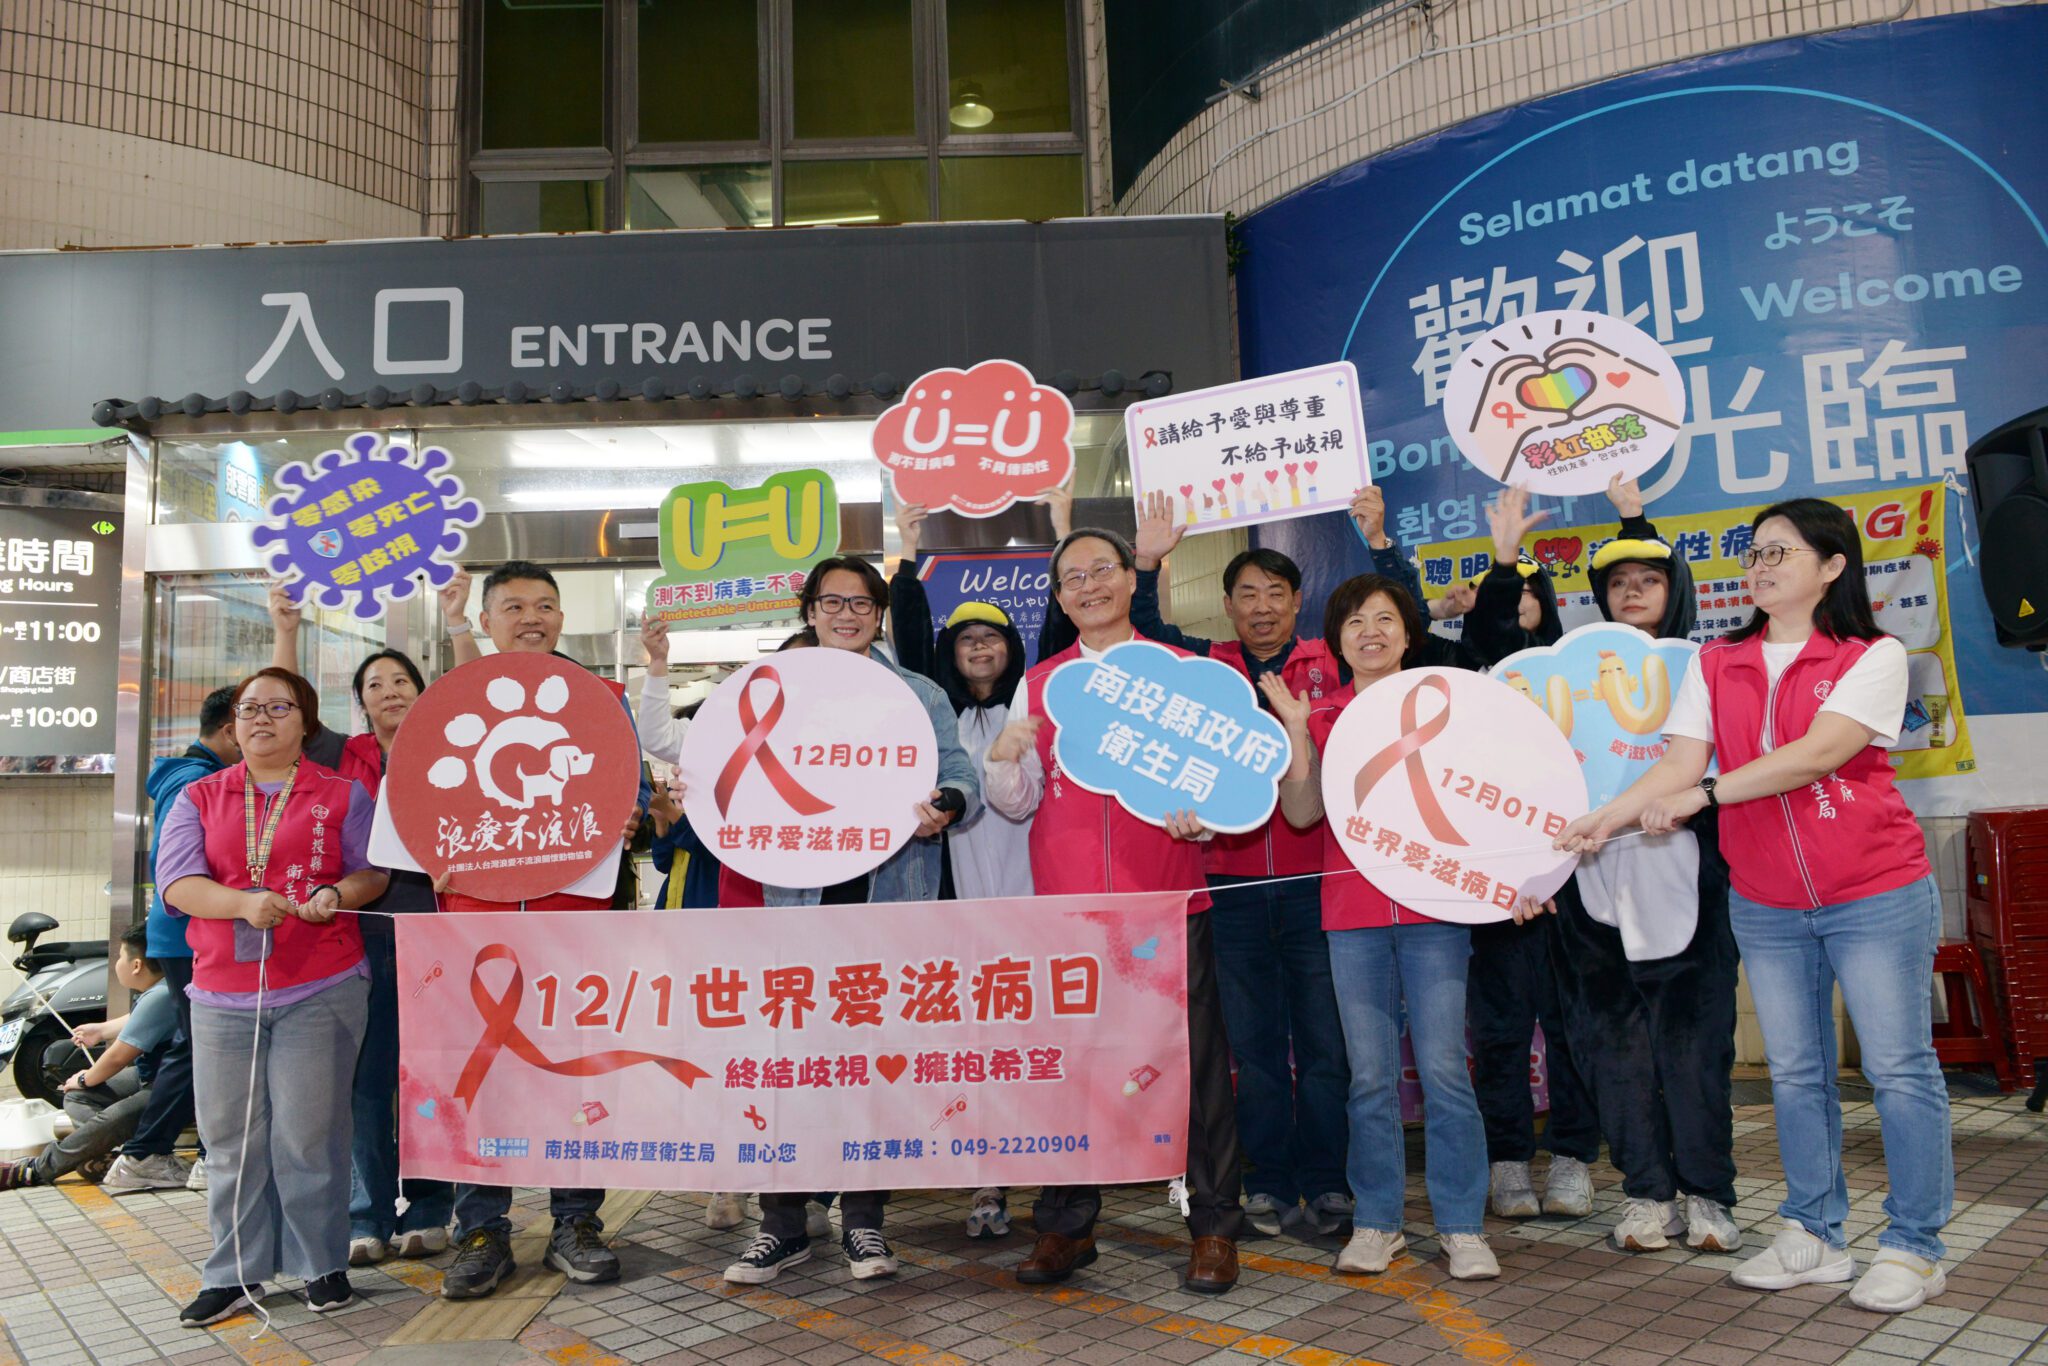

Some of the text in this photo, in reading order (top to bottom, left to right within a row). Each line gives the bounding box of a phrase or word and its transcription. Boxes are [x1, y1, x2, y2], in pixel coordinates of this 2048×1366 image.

[1459, 139, 1862, 247] Selamat datang
[1763, 195, 1916, 251] ようこそ
[1408, 231, 1713, 406] 歡迎
[1739, 264, 2024, 322] Welcome
[245, 287, 464, 385] 入口
[511, 317, 833, 368] ENTRANCE
[1157, 395, 1326, 446] 請給予愛與尊重
[1521, 413, 1647, 469] 彩虹部落
[1640, 338, 1970, 505] 光臨
[290, 477, 382, 527] 零感染
[346, 490, 436, 538] 零死亡
[672, 480, 823, 571] U=U
[0, 538, 94, 576] 時間
[19, 578, 74, 592] Hours
[960, 565, 1050, 594] Welco
[658, 604, 737, 622] Undetectable
[1083, 661, 1284, 774] 南投縣政府
[792, 743, 918, 768] 12月01日
[1096, 720, 1221, 803] 衛生局
[436, 802, 603, 859] 浪愛不流浪
[1440, 767, 1569, 838] 12月01日
[717, 824, 892, 852] 世界愛滋病日
[1345, 814, 1518, 912] 世界愛滋病日
[724, 1047, 1065, 1090] 終結歧視 擁抱希望
[544, 1139, 716, 1163] 南投縣政府暨衛生局
[737, 1142, 797, 1164] 關心您
[950, 1135, 1090, 1156] 049-2220904
